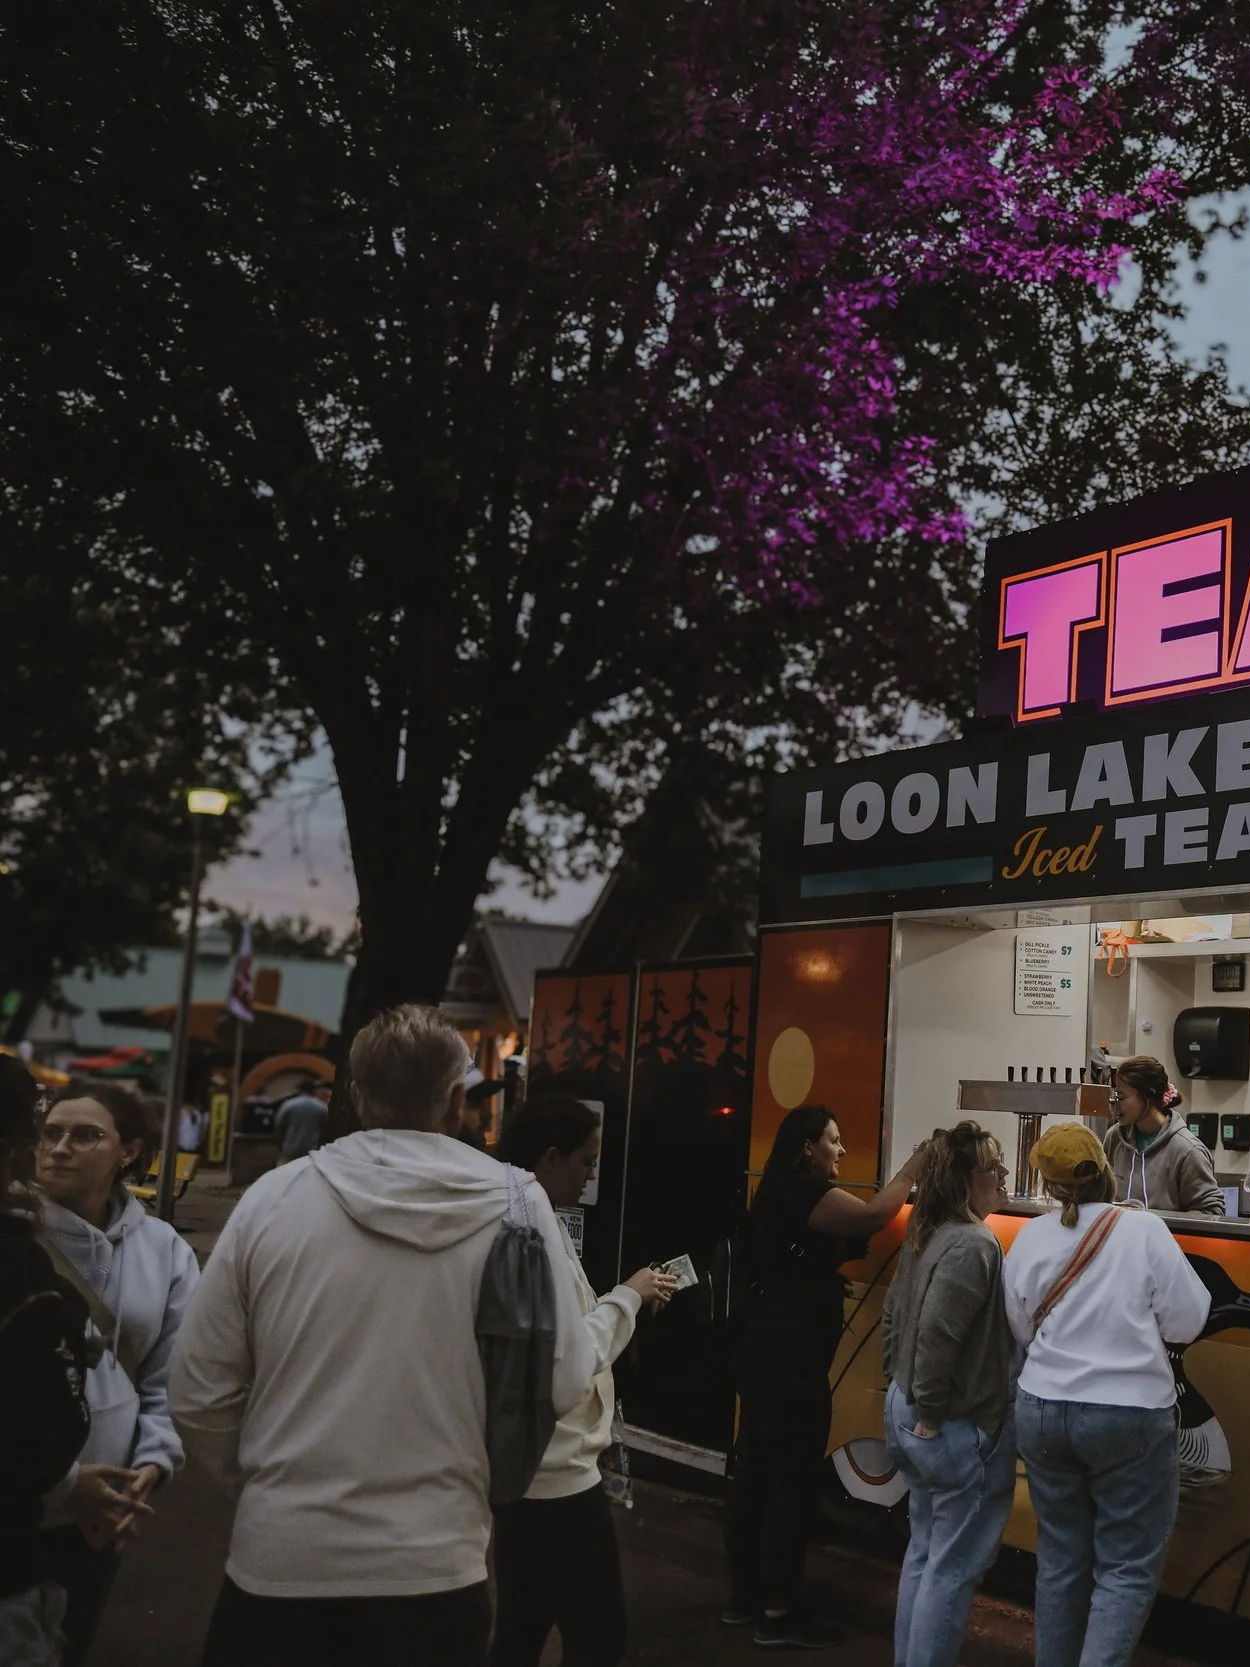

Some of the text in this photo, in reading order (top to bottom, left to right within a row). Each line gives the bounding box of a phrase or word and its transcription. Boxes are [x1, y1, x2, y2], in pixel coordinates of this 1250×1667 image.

[803, 762, 999, 846] LOON
[1002, 825, 1103, 880] Iced
[1061, 946, 1072, 955] $7
[1060, 979, 1071, 988] $5
